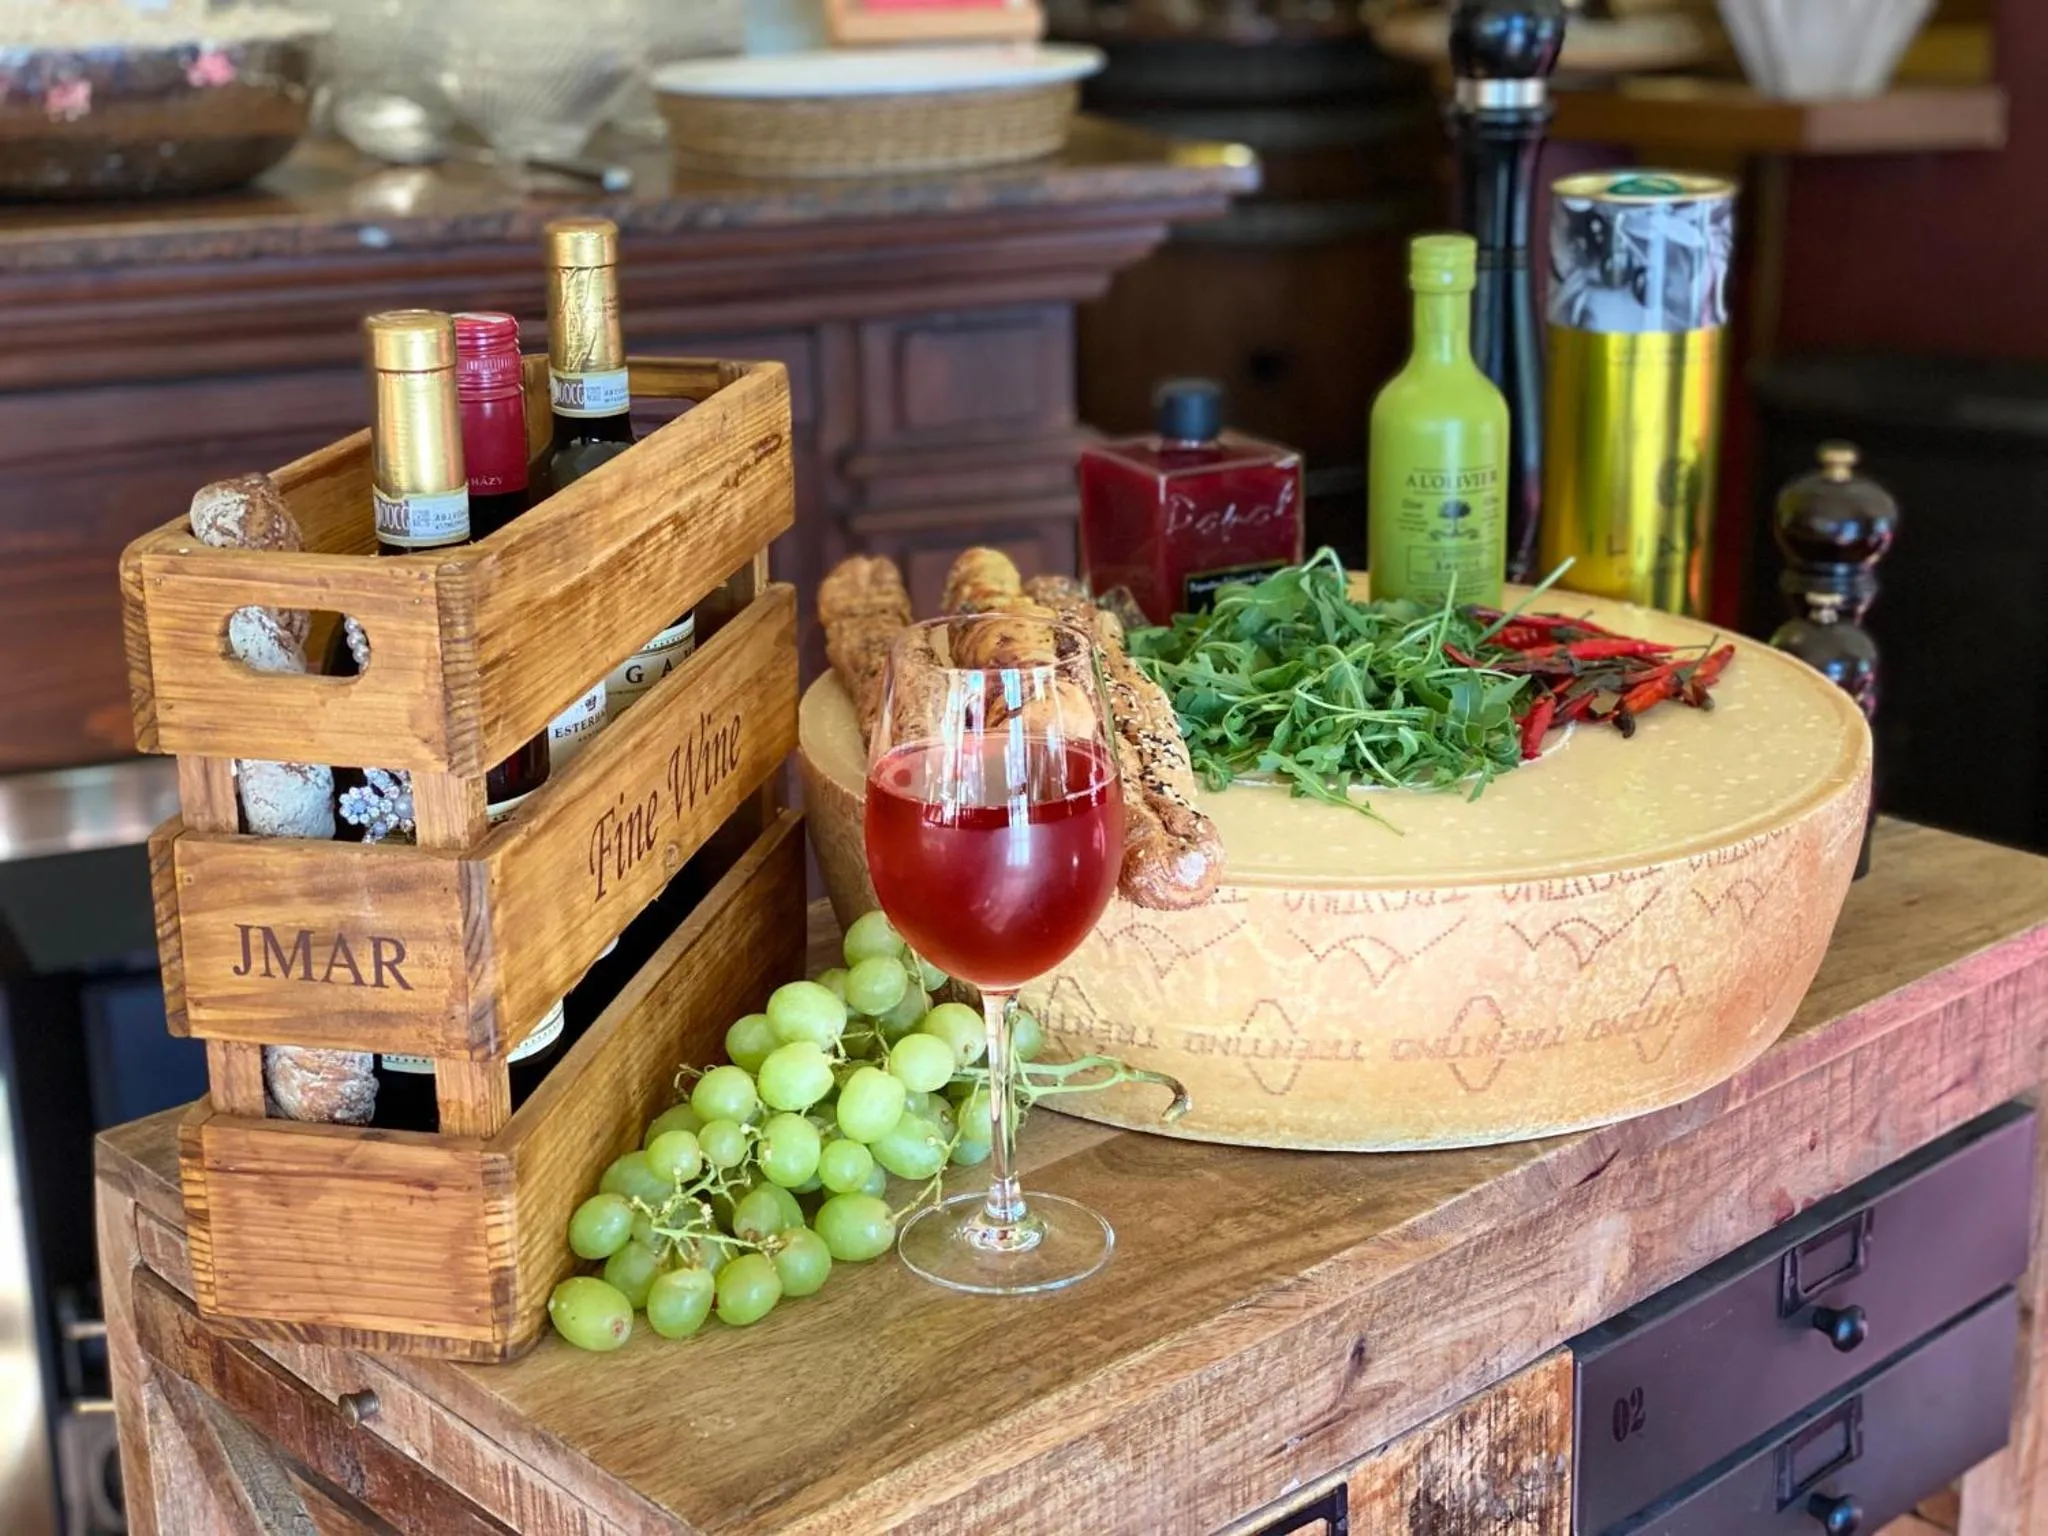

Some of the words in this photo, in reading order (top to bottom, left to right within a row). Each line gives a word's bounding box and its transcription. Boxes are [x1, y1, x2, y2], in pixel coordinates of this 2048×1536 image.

[589, 790, 659, 904] Fine
[667, 711, 742, 821] Wine
[232, 923, 415, 991] JMAR
[1612, 1386, 1647, 1443] 02
